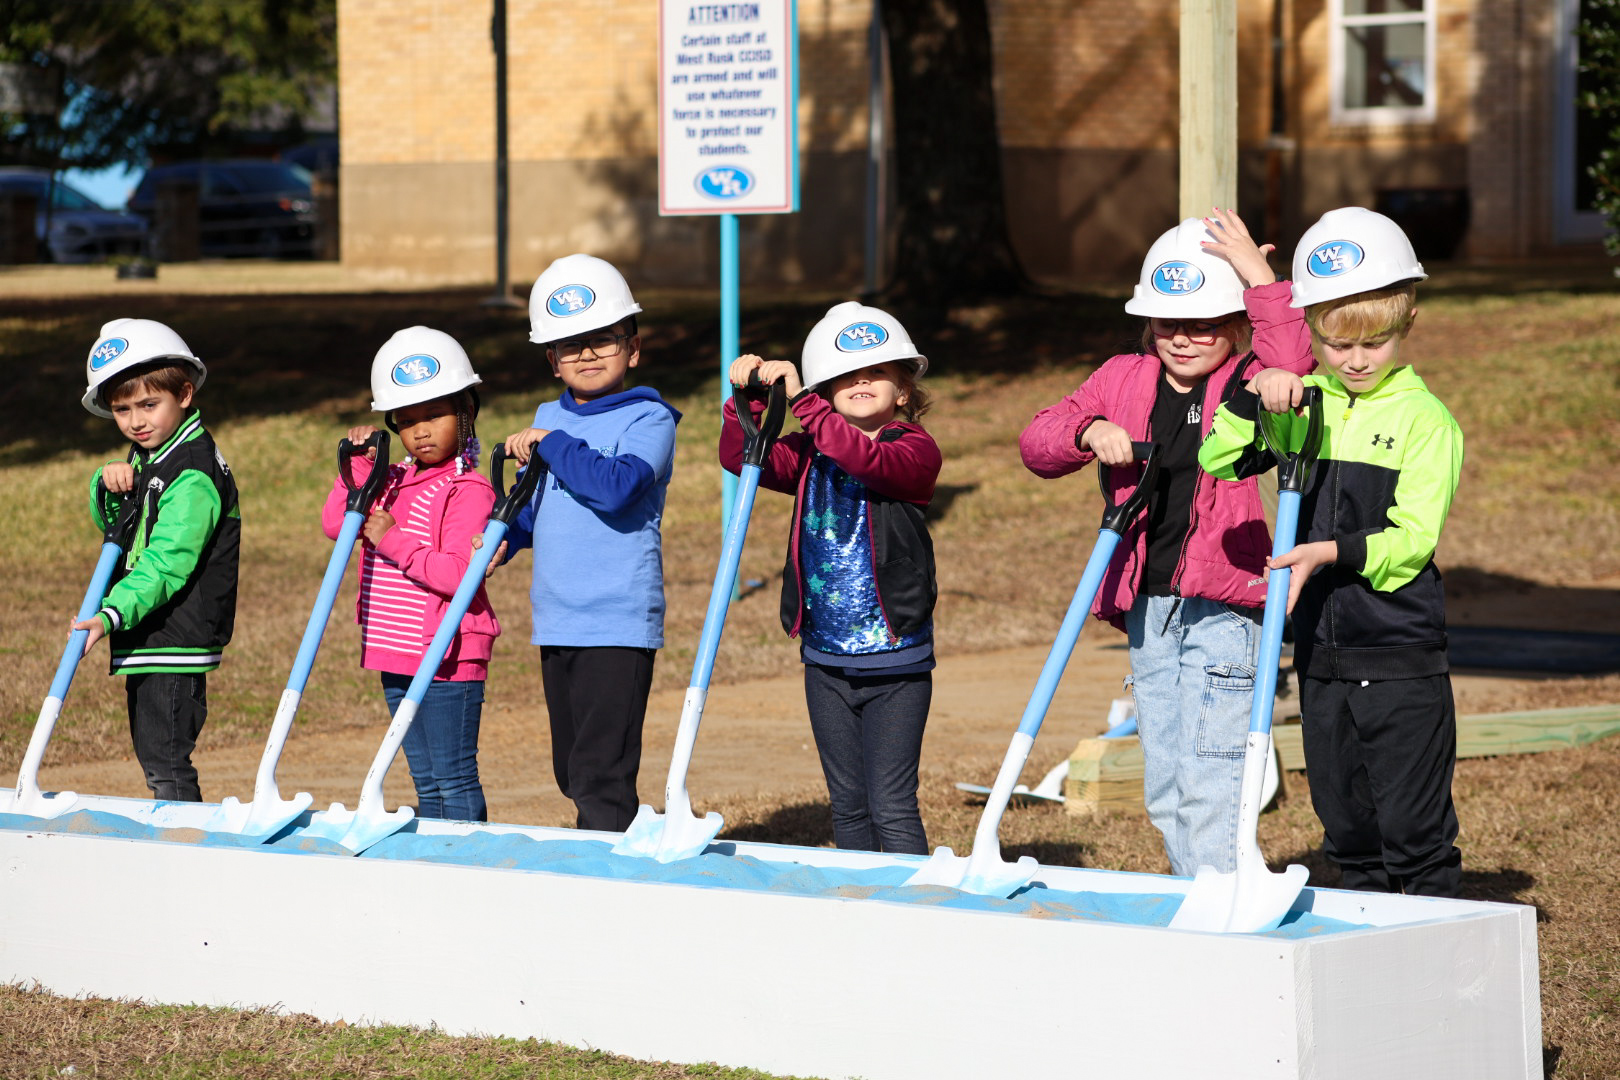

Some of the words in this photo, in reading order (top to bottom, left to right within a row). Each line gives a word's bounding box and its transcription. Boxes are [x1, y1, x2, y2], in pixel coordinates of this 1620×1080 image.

[688, 3, 759, 24] ATTENTION
[682, 35, 721, 47] Certain
[726, 32, 751, 45] staff
[756, 32, 766, 43] at
[677, 53, 703, 65] West
[708, 52, 733, 64] Rusk
[672, 75, 688, 84] are
[694, 71, 728, 83] armed
[733, 69, 752, 81] and
[758, 67, 777, 79] will
[687, 92, 705, 101] use
[711, 88, 762, 100] whatever
[673, 108, 701, 120] force
[706, 108, 714, 119] is
[720, 107, 776, 120] necessary
[686, 127, 696, 138] to
[702, 125, 740, 139] protect
[745, 125, 763, 136] our
